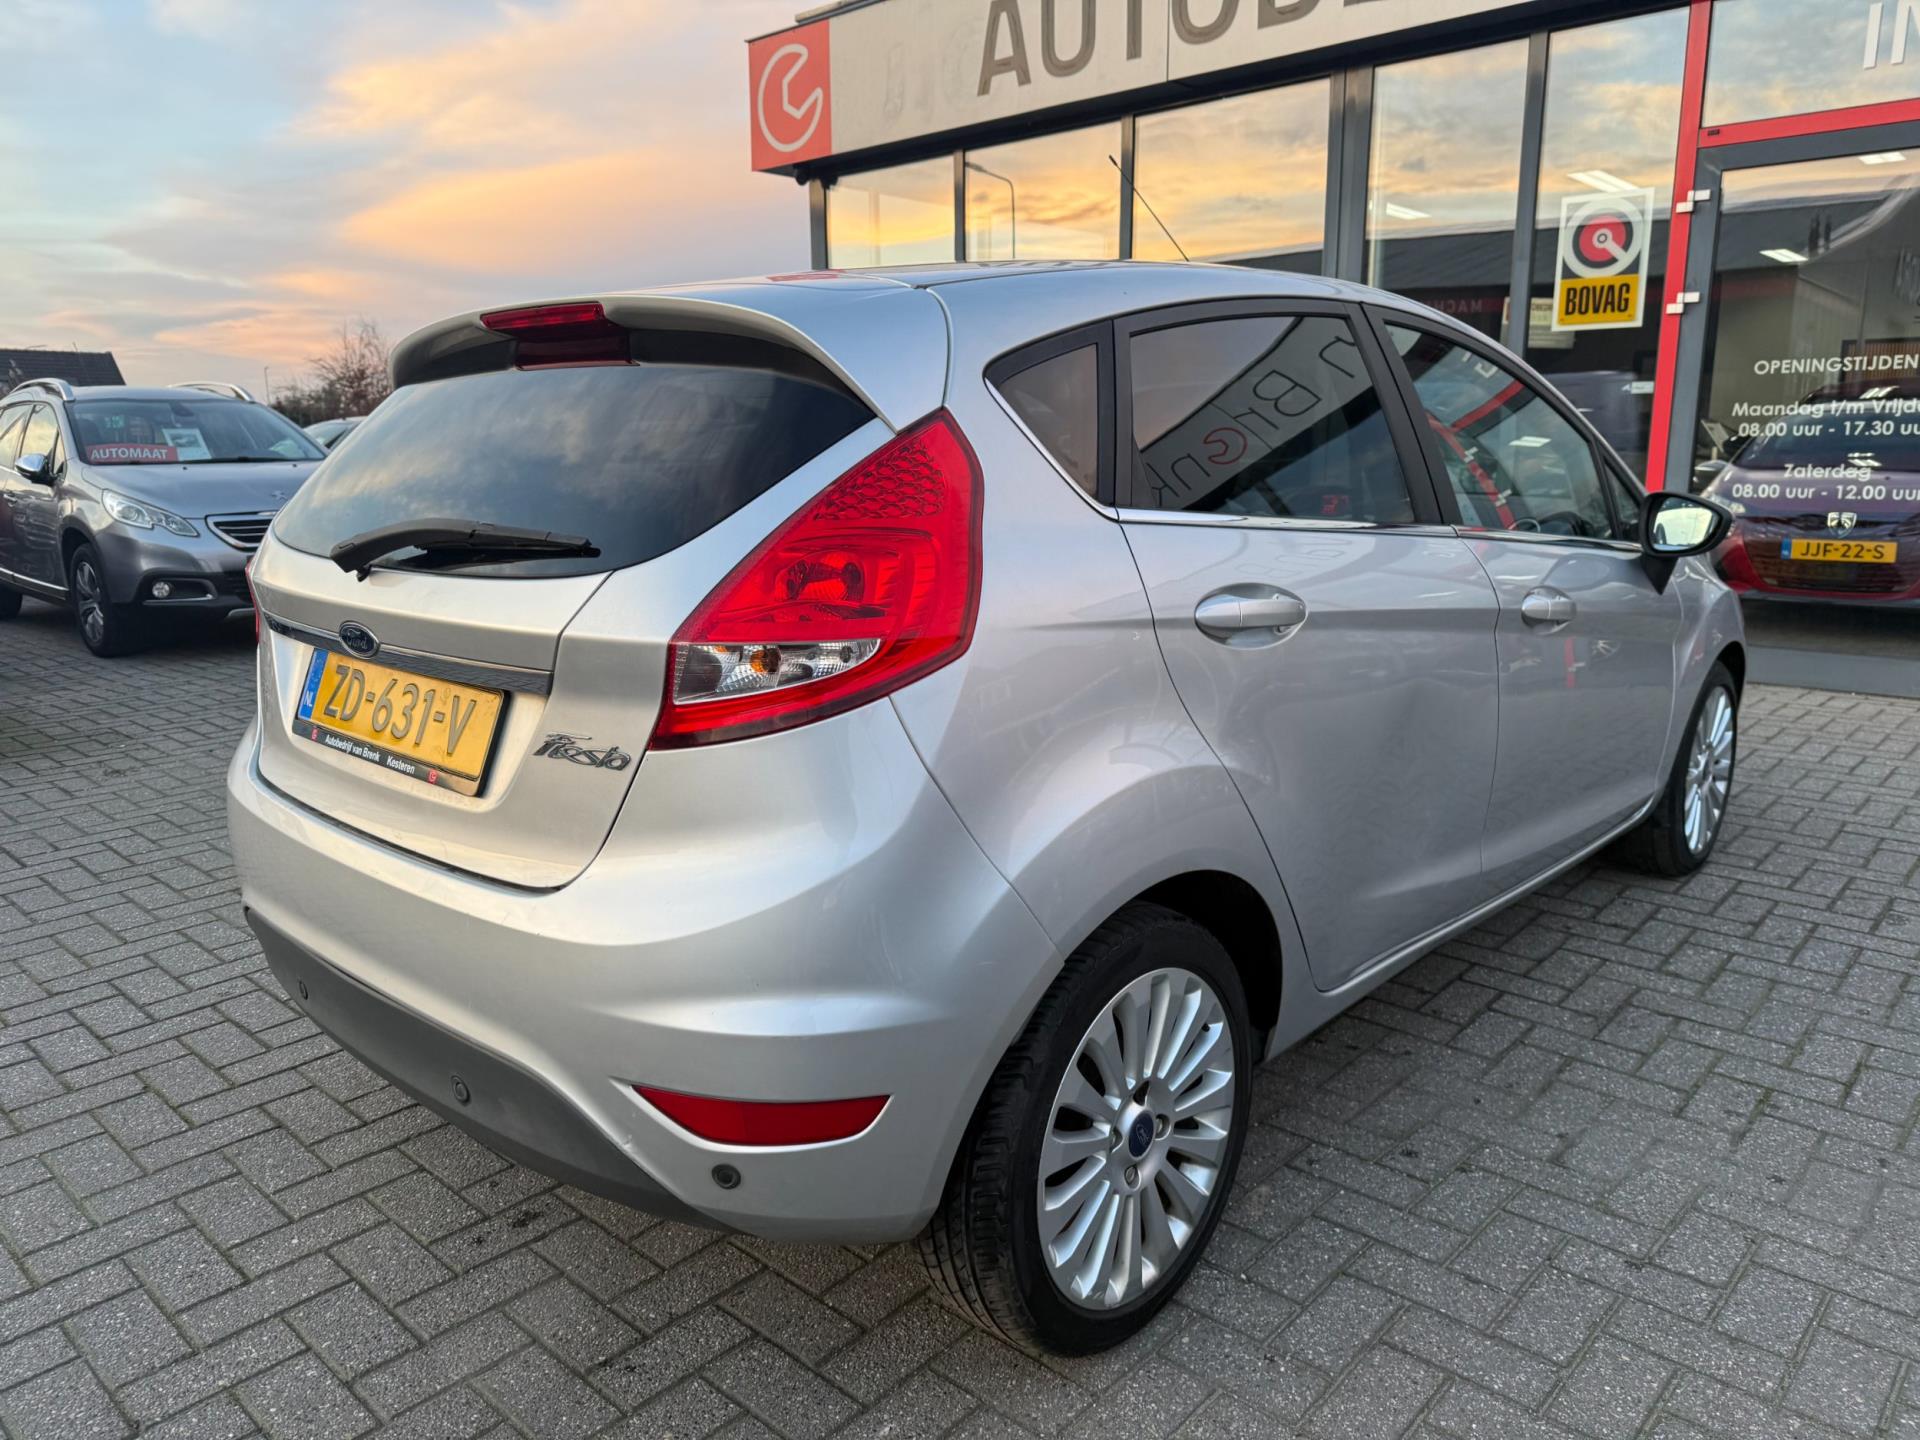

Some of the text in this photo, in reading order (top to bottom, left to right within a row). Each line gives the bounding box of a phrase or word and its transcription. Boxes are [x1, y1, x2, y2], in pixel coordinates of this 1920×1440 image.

[1564, 282, 1630, 316] BOVAG
[1753, 353, 1919, 375] OPENINGSTIJDEN
[1731, 401, 1824, 418] Maandag
[1829, 398, 1865, 415] t/m
[1738, 422, 1787, 437] 08.00
[1792, 423, 1823, 437] uur
[1844, 420, 1895, 437] 17.30
[91, 447, 168, 460] AUTOMAAT
[1783, 463, 1872, 482] Zaterdag
[1732, 483, 1780, 499] 08.00
[1785, 485, 1815, 499] uur
[1836, 484, 1886, 500] 12.00
[1801, 541, 1885, 560] JJF-22-S
[323, 664, 477, 757] ZD-631-V
[325, 734, 416, 775] Autobedrijf van Brenk Kesteren
